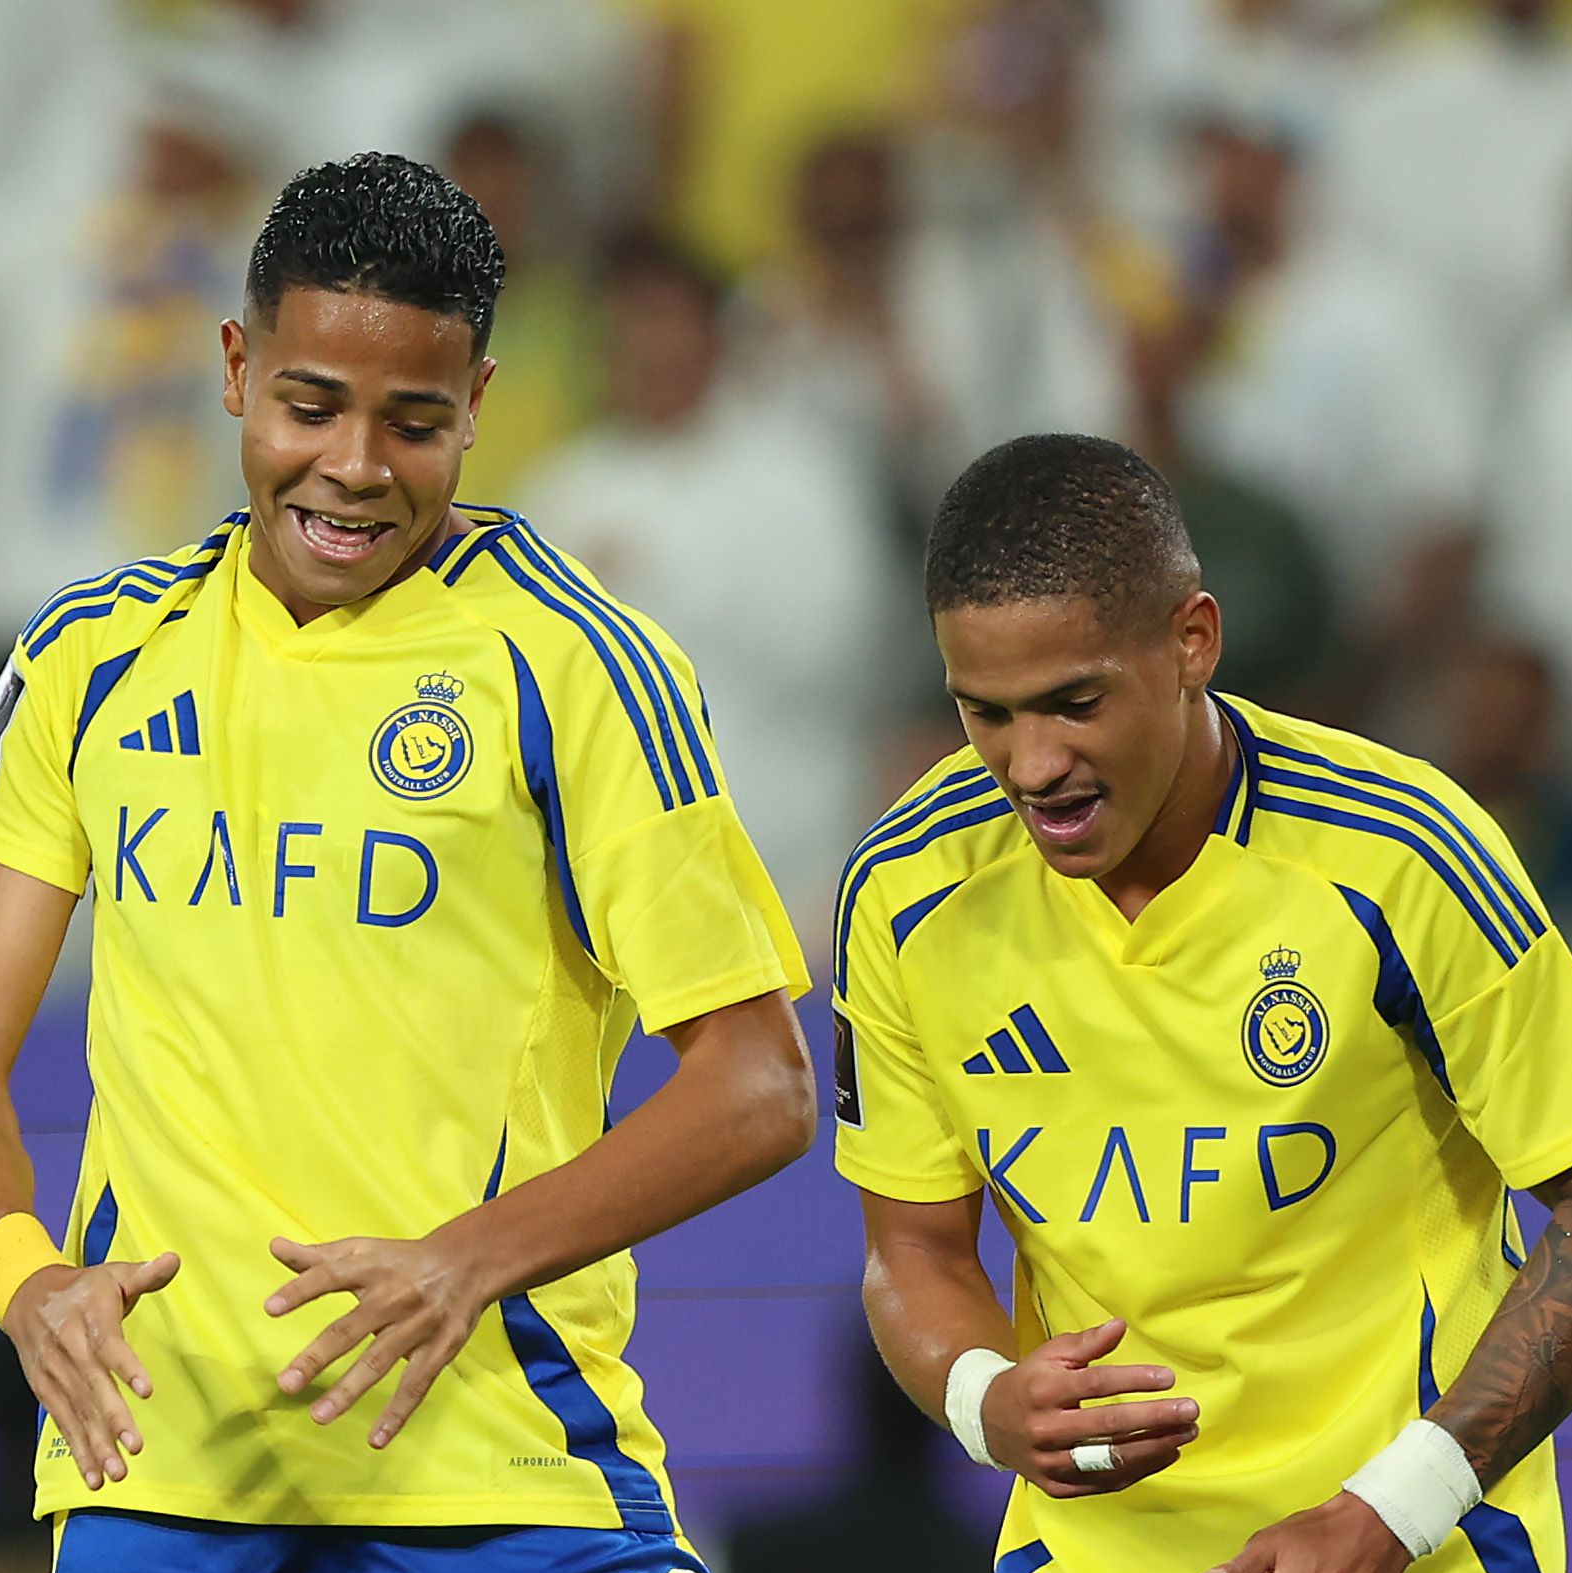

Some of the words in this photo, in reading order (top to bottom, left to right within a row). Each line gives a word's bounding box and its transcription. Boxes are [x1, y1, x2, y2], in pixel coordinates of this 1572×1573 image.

[395, 713, 416, 731] AL
[418, 711, 461, 742] NASSR
[382, 759, 423, 790] FOOTBALL
[425, 770, 450, 788] CLUB
[115, 805, 439, 928] KAFD
[1254, 1000, 1271, 1022] AL
[1270, 991, 1313, 1015] NASSR
[1299, 1046, 1317, 1070] CLUB
[976, 1122, 1336, 1224] KAFD
[509, 1457, 568, 1467] AEROREADY
